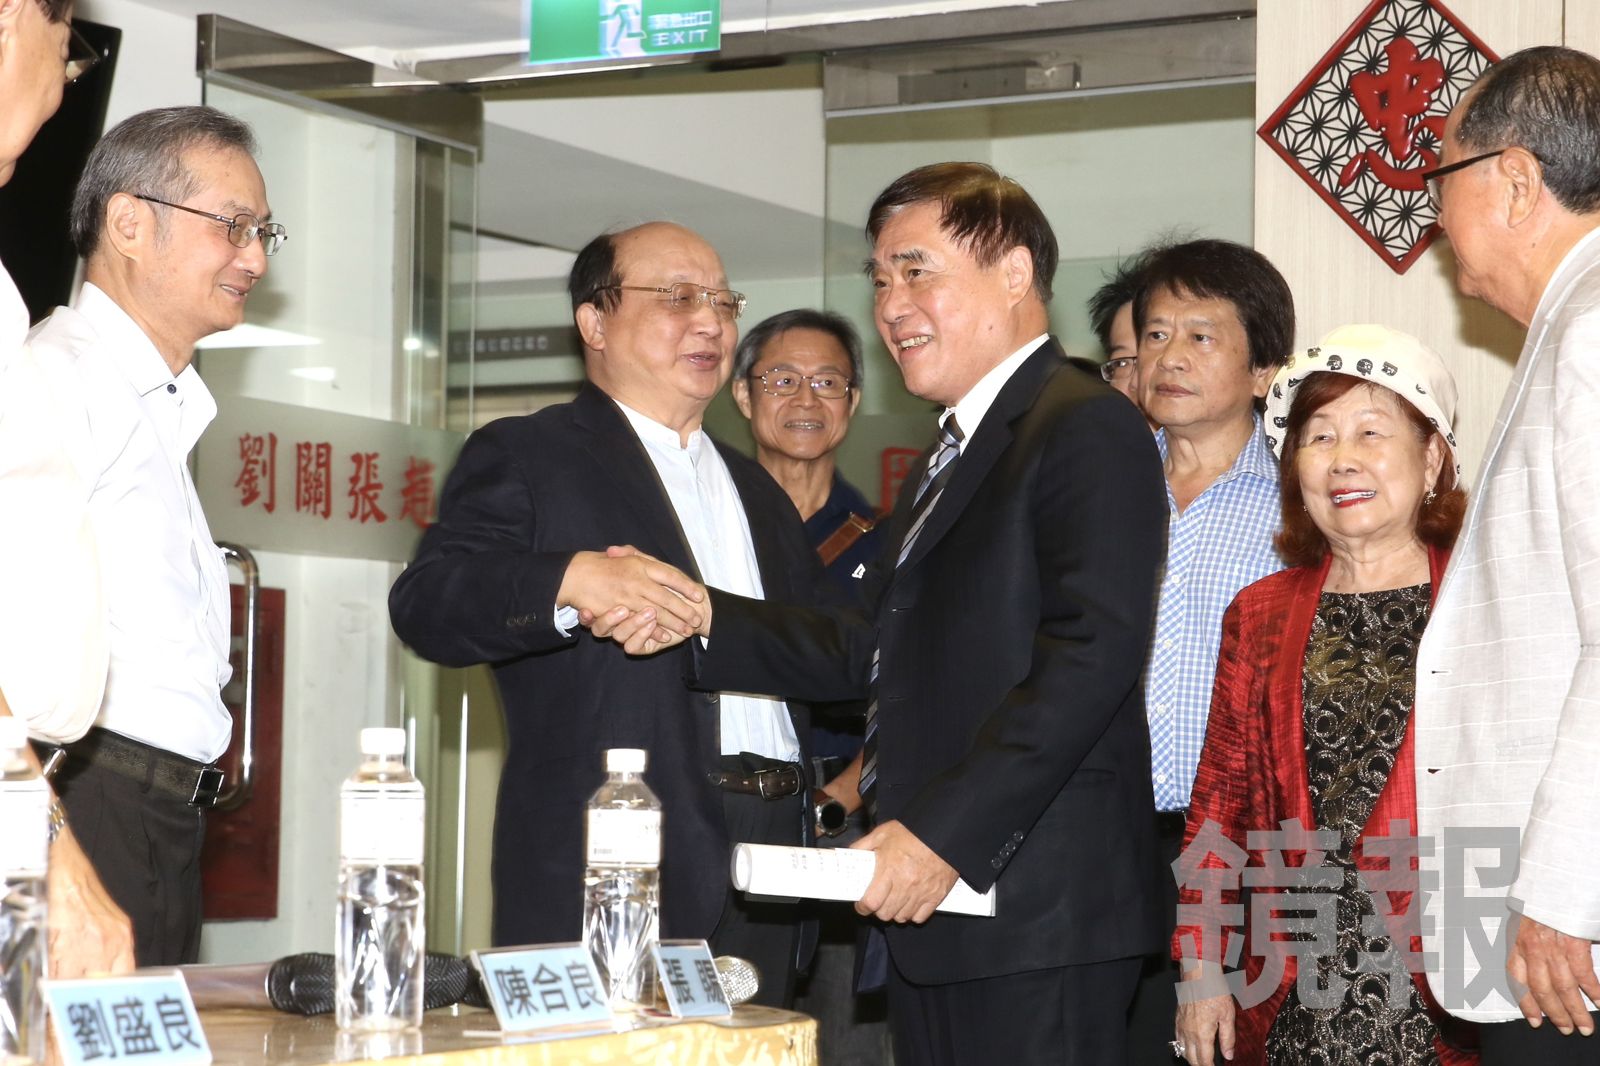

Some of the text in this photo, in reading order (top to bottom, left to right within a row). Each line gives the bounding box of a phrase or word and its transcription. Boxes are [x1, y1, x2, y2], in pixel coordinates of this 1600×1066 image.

[652, 29, 708, 46] EXIT
[493, 959, 606, 1020] 陳合良
[66, 994, 202, 1061] 劉盛良
